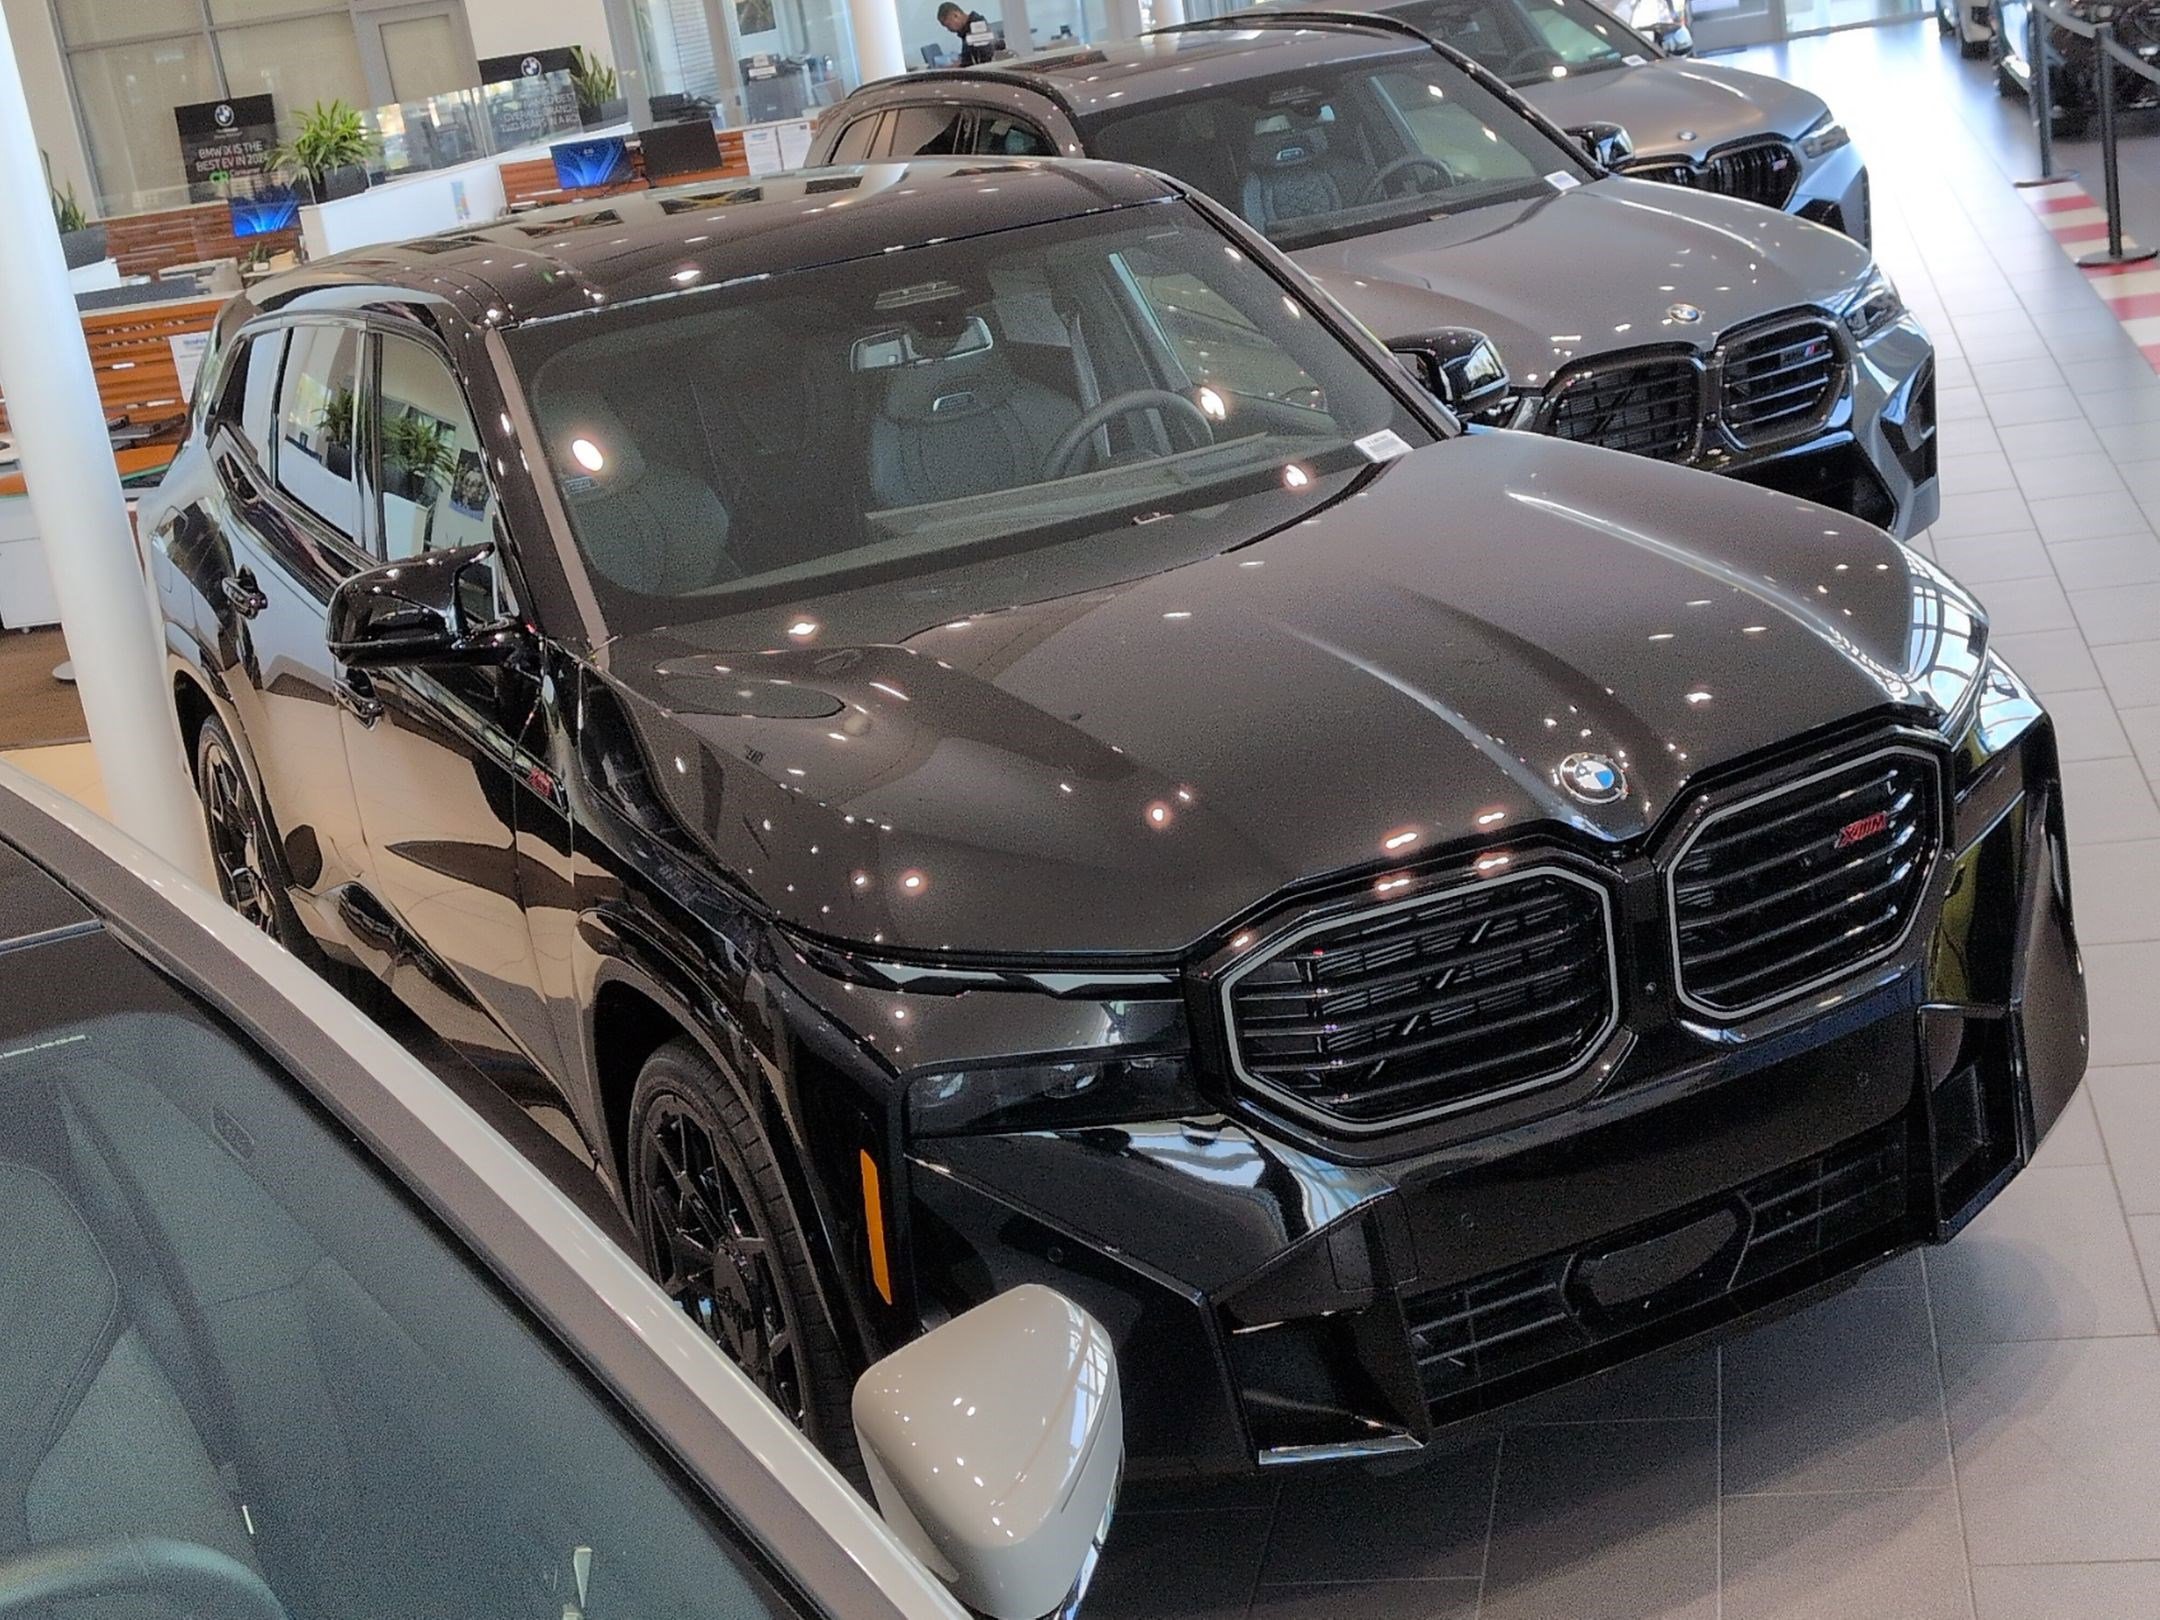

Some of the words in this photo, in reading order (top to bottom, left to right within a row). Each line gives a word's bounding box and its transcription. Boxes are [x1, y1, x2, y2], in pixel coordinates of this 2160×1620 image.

[199, 147, 222, 159] BMW
[233, 143, 243, 154] IS
[243, 141, 263, 153] THE
[196, 159, 220, 172] BEST
[221, 156, 234, 168] EV
[235, 155, 246, 166] IN
